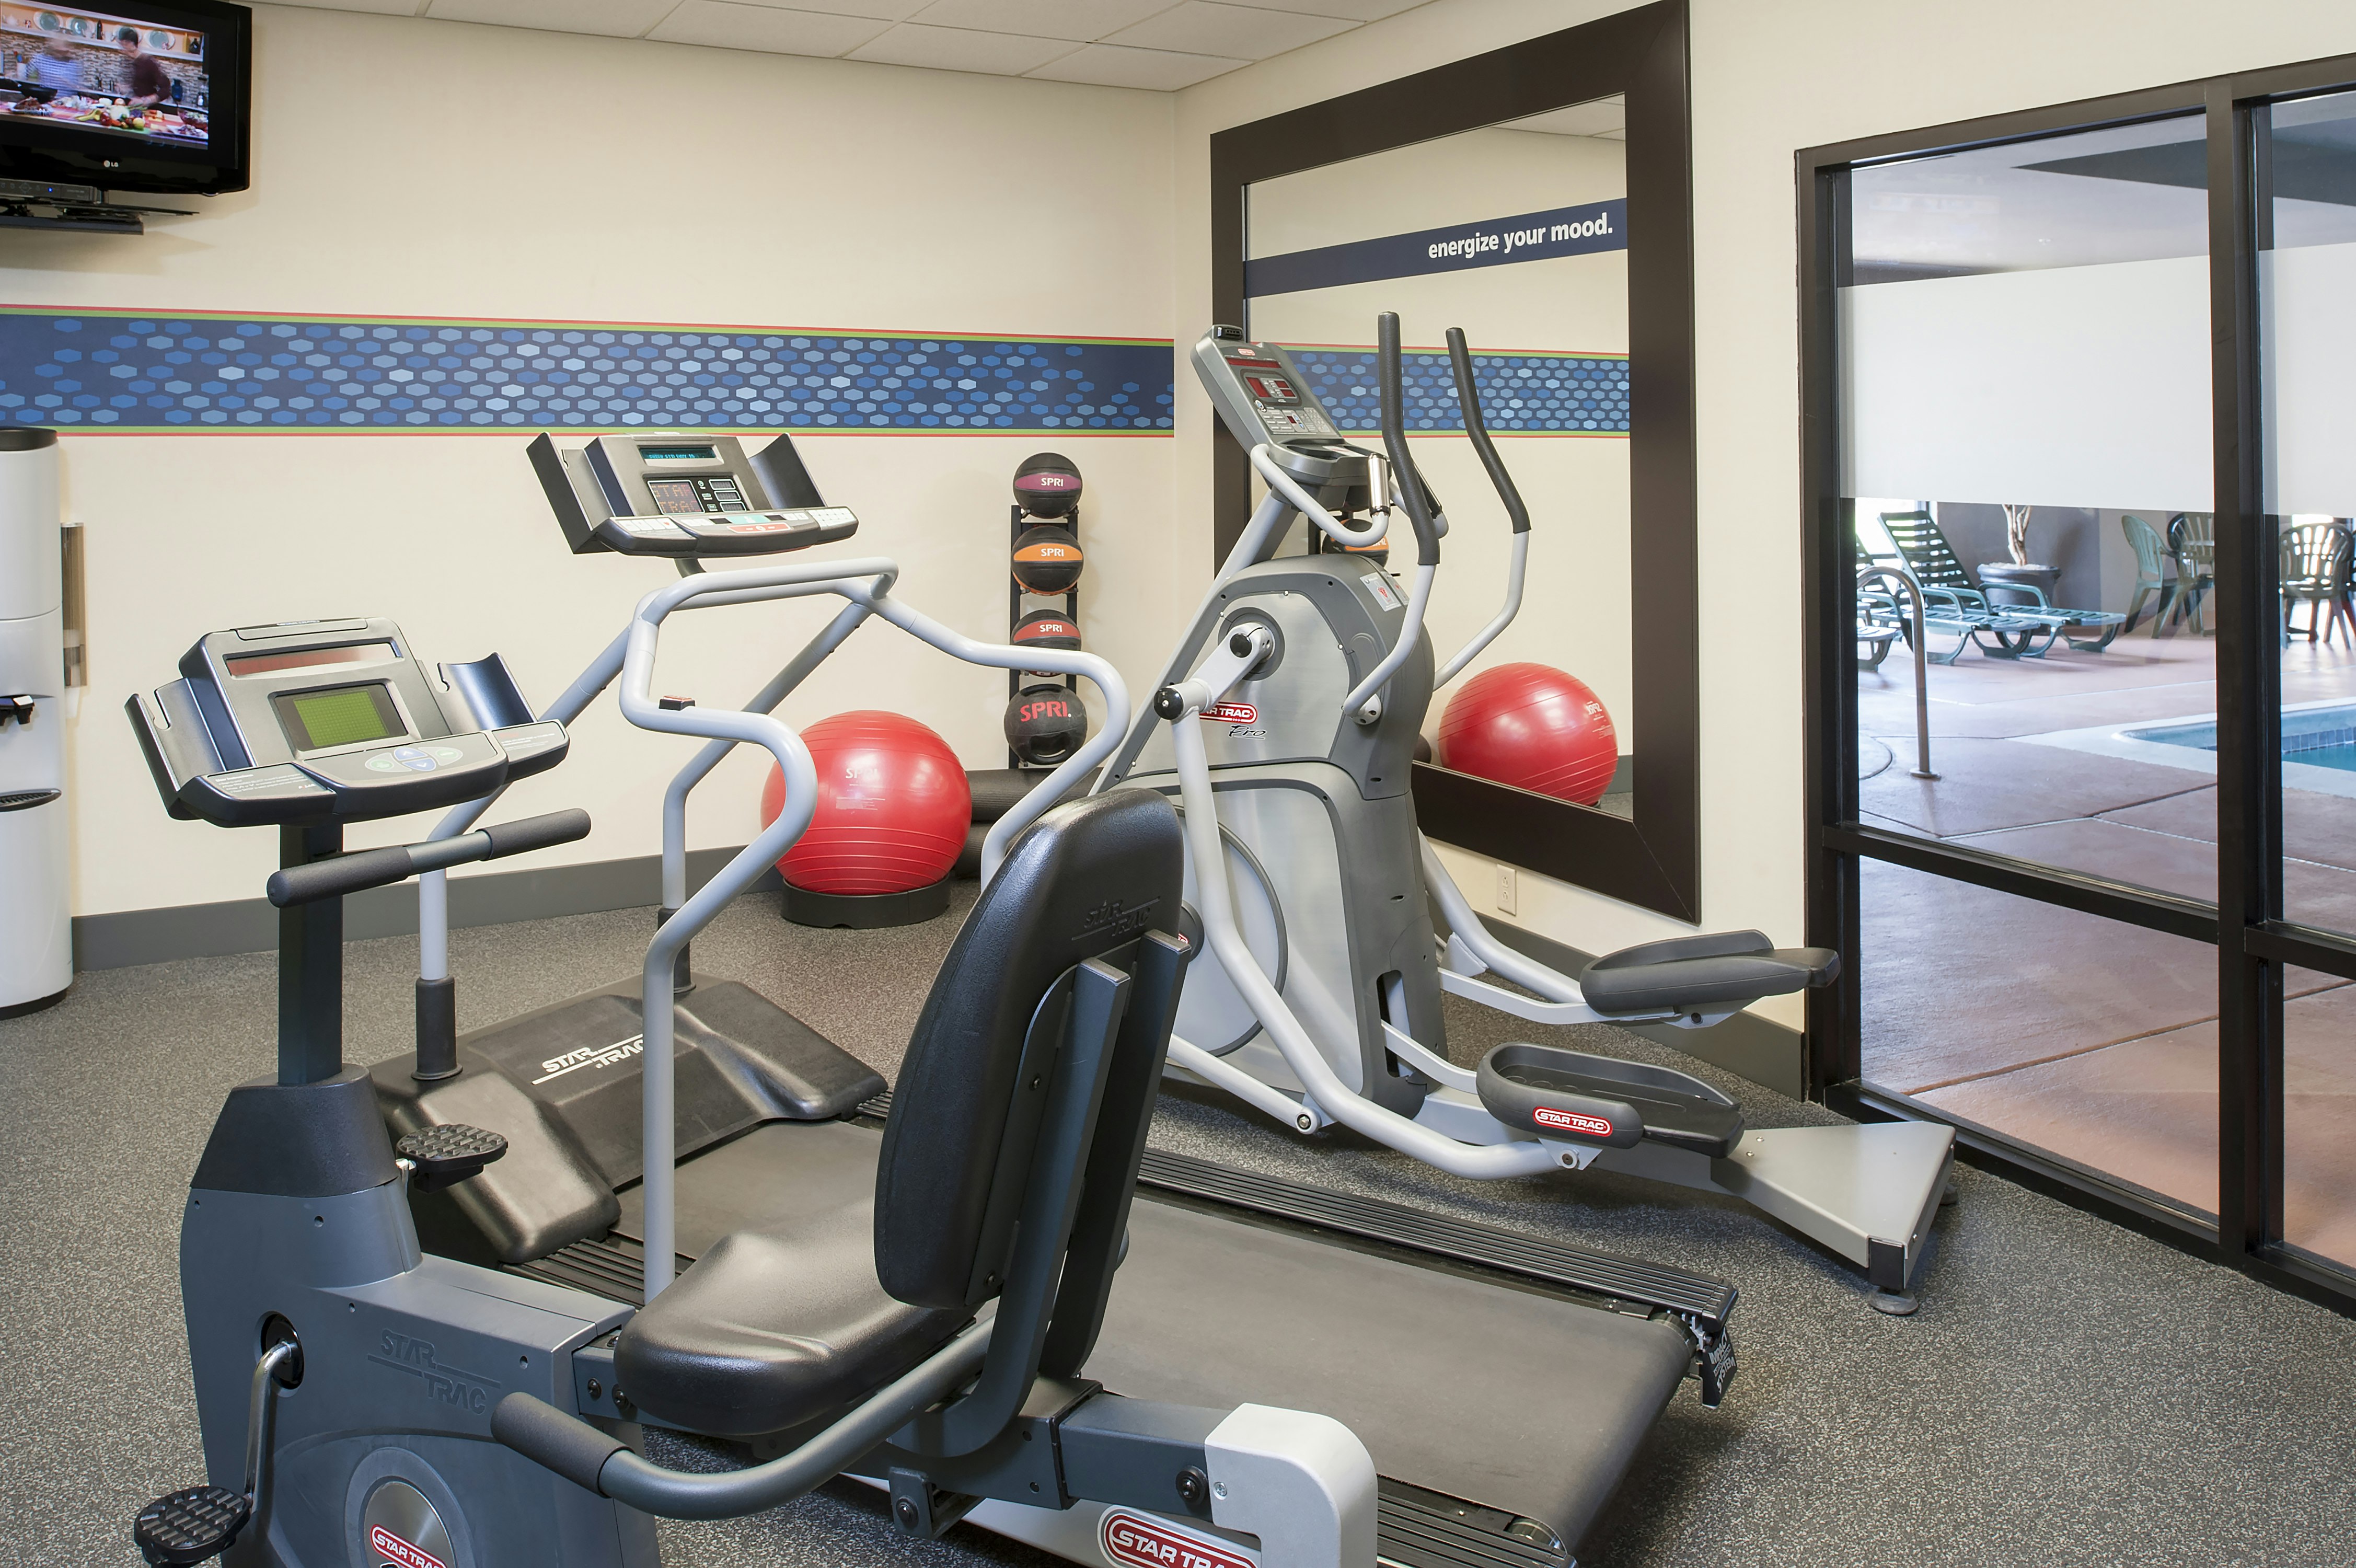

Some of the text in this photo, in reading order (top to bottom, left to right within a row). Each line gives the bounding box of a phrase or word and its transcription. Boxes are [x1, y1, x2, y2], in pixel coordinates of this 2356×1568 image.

[1428, 212, 1613, 259] energize your mood.
[1041, 478, 1064, 487] SPRI
[1041, 548, 1065, 557] SPRI
[1039, 624, 1063, 633] SPRI
[1219, 708, 1251, 718] TRAC
[1228, 724, 1267, 737] Pro
[1084, 900, 1124, 928] STAR
[1112, 907, 1150, 937] TRAC
[542, 1046, 599, 1073] STAR
[1539, 1112, 1604, 1130] STAR TRAC
[380, 1328, 437, 1369] STAR
[422, 1371, 487, 1415] TRAC
[377, 1534, 441, 1568] STAR TRA
[1119, 1529, 1177, 1563] STAR
